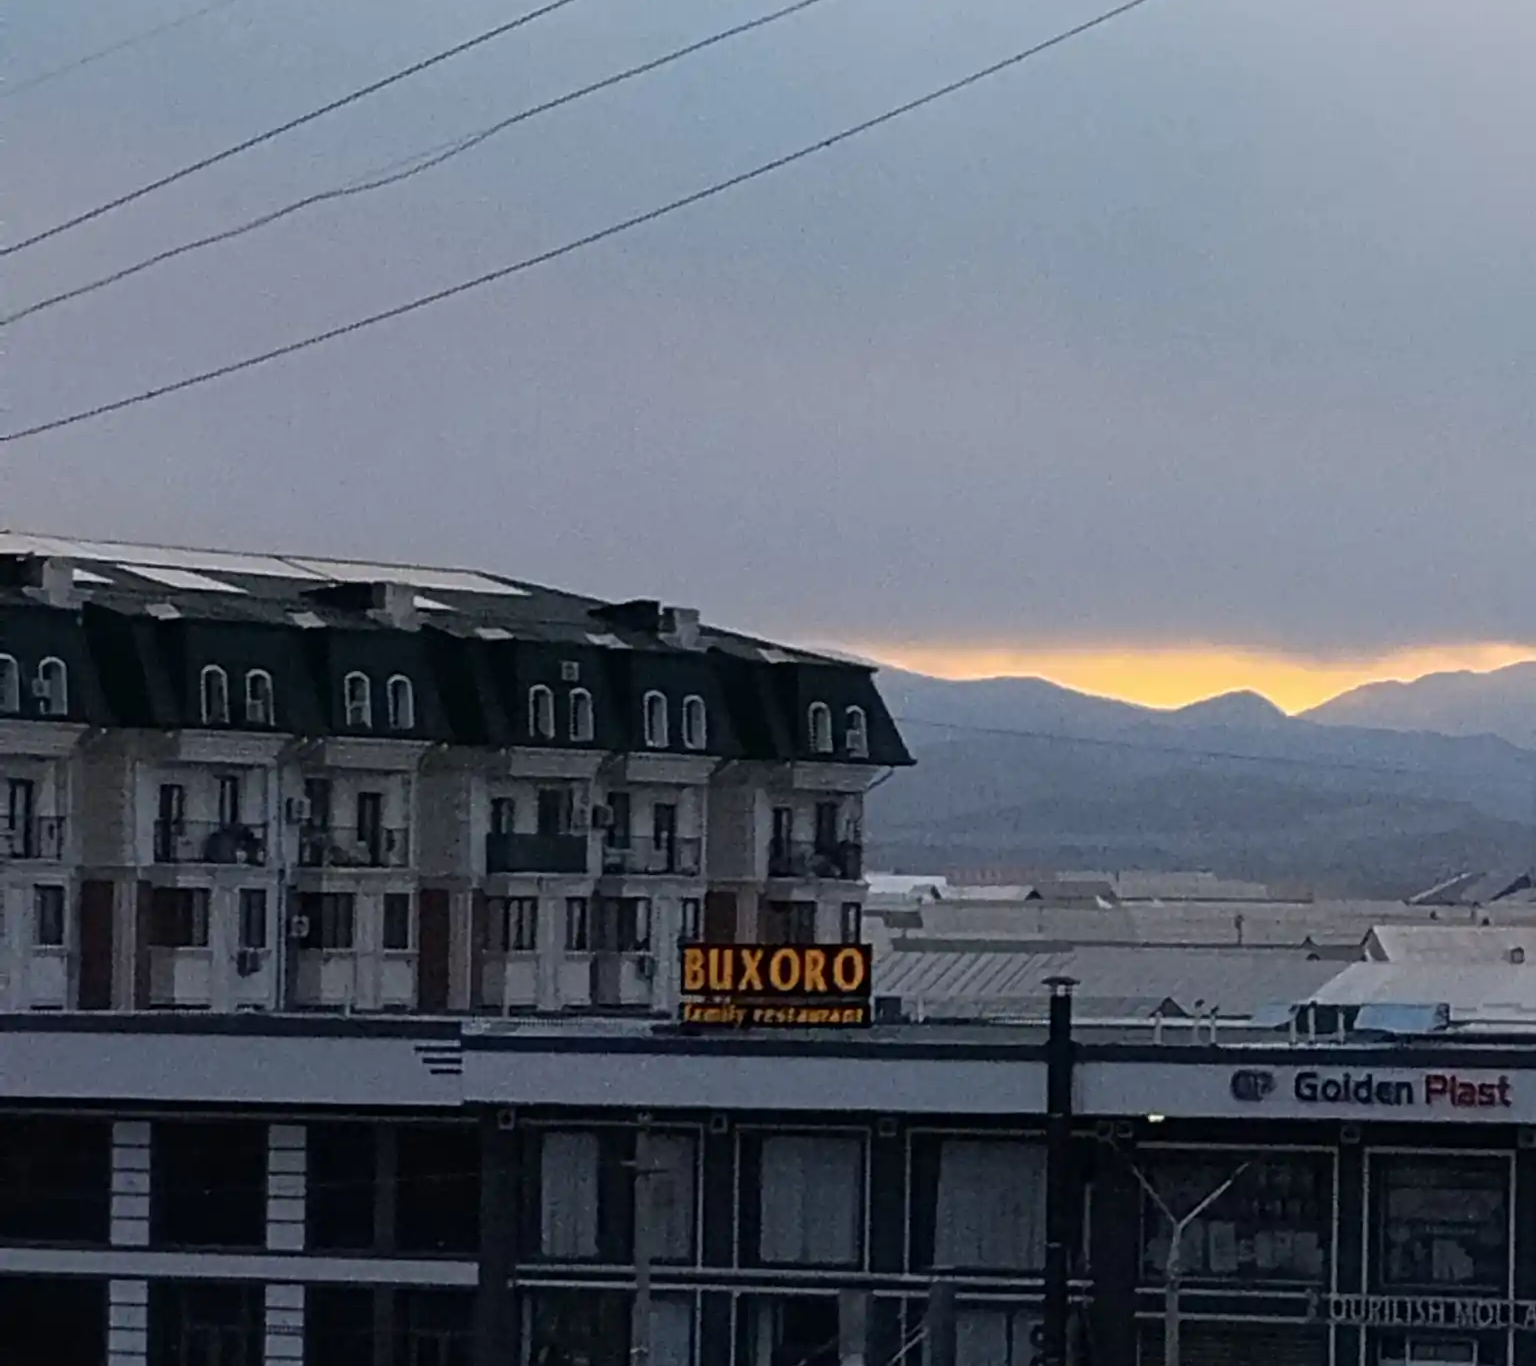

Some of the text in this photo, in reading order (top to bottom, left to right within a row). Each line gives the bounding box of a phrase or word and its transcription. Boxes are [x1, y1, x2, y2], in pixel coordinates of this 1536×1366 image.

[684, 948, 864, 992] BUXORO
[684, 1005, 864, 1027] family restaurant
[1294, 1071, 1415, 1105] Golden
[1424, 1074, 1513, 1108] Plast
